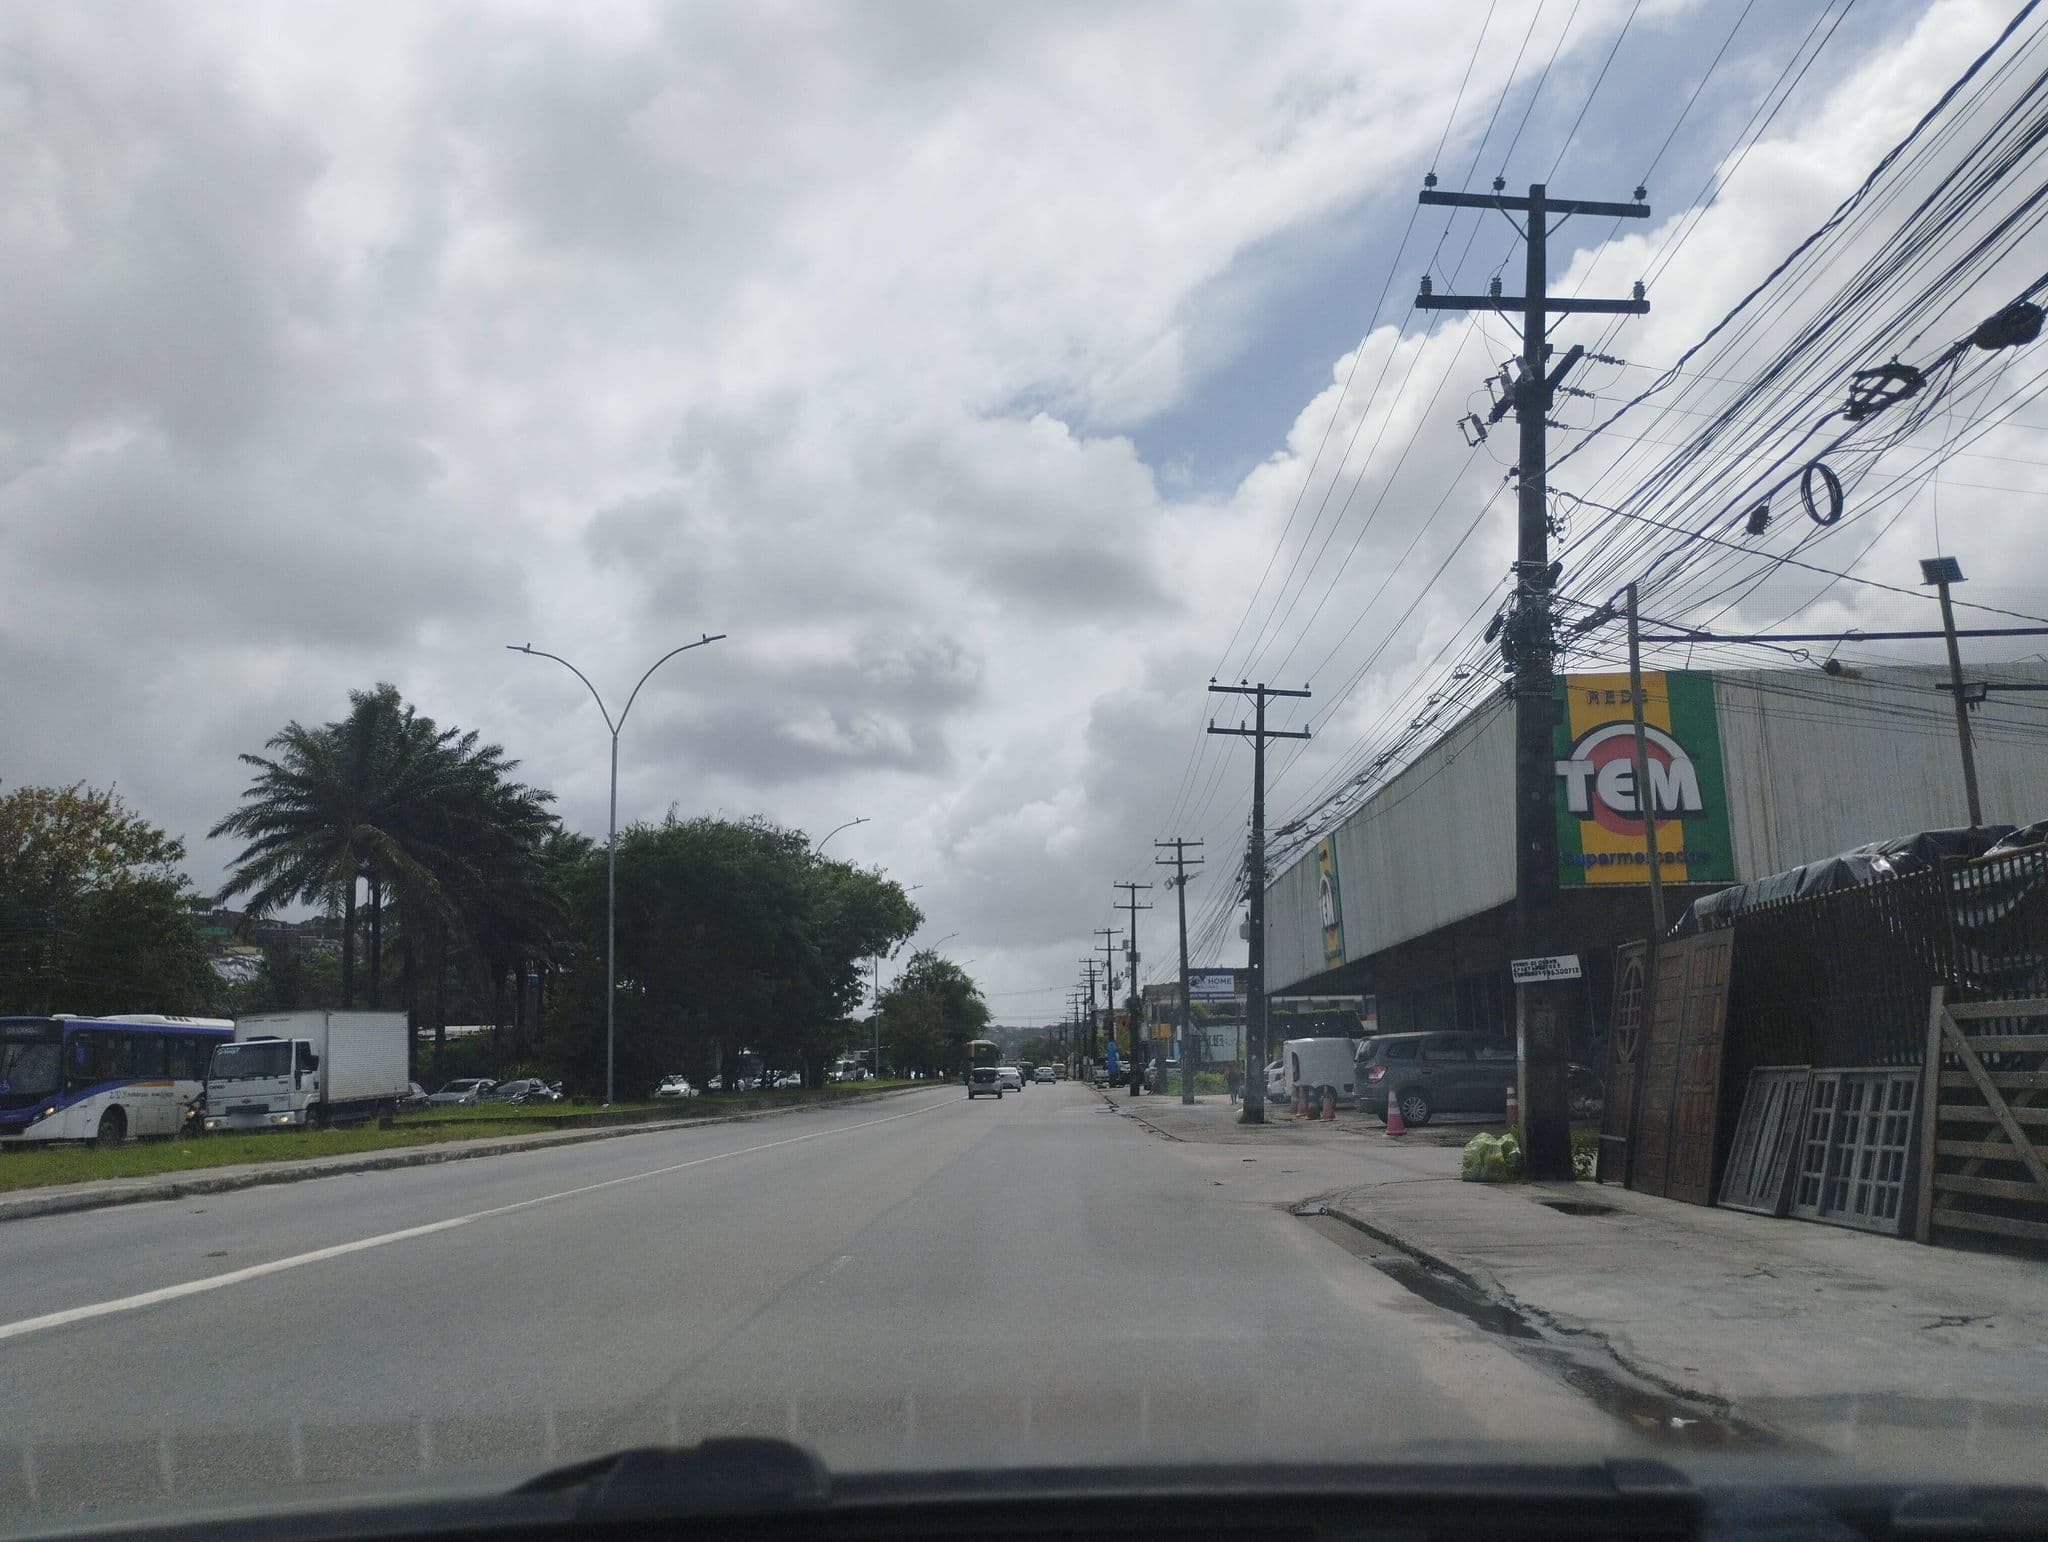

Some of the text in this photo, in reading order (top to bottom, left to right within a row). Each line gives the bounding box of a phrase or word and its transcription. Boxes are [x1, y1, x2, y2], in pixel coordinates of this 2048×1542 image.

[1587, 689, 1648, 704] REDE
[1554, 757, 1703, 812] TEM
[1208, 977, 1233, 985] HOME
